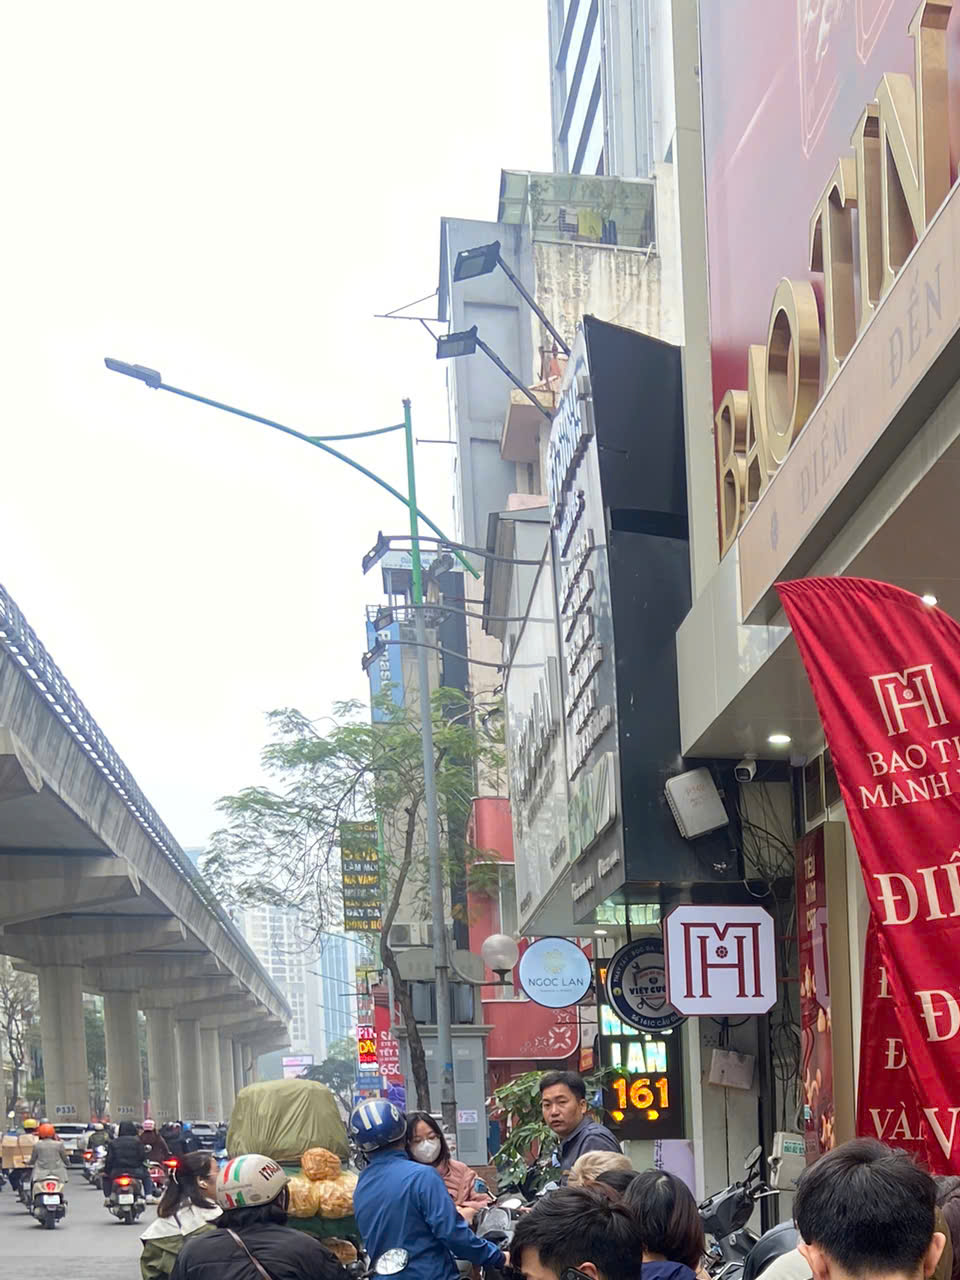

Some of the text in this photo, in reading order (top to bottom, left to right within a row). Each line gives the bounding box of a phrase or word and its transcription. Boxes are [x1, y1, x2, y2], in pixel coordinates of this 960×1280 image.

[867, 744, 927, 777] BAO
[859, 771, 953, 810] MANH
[561, 977, 585, 987] LAN
[612, 1077, 670, 1110] 161
